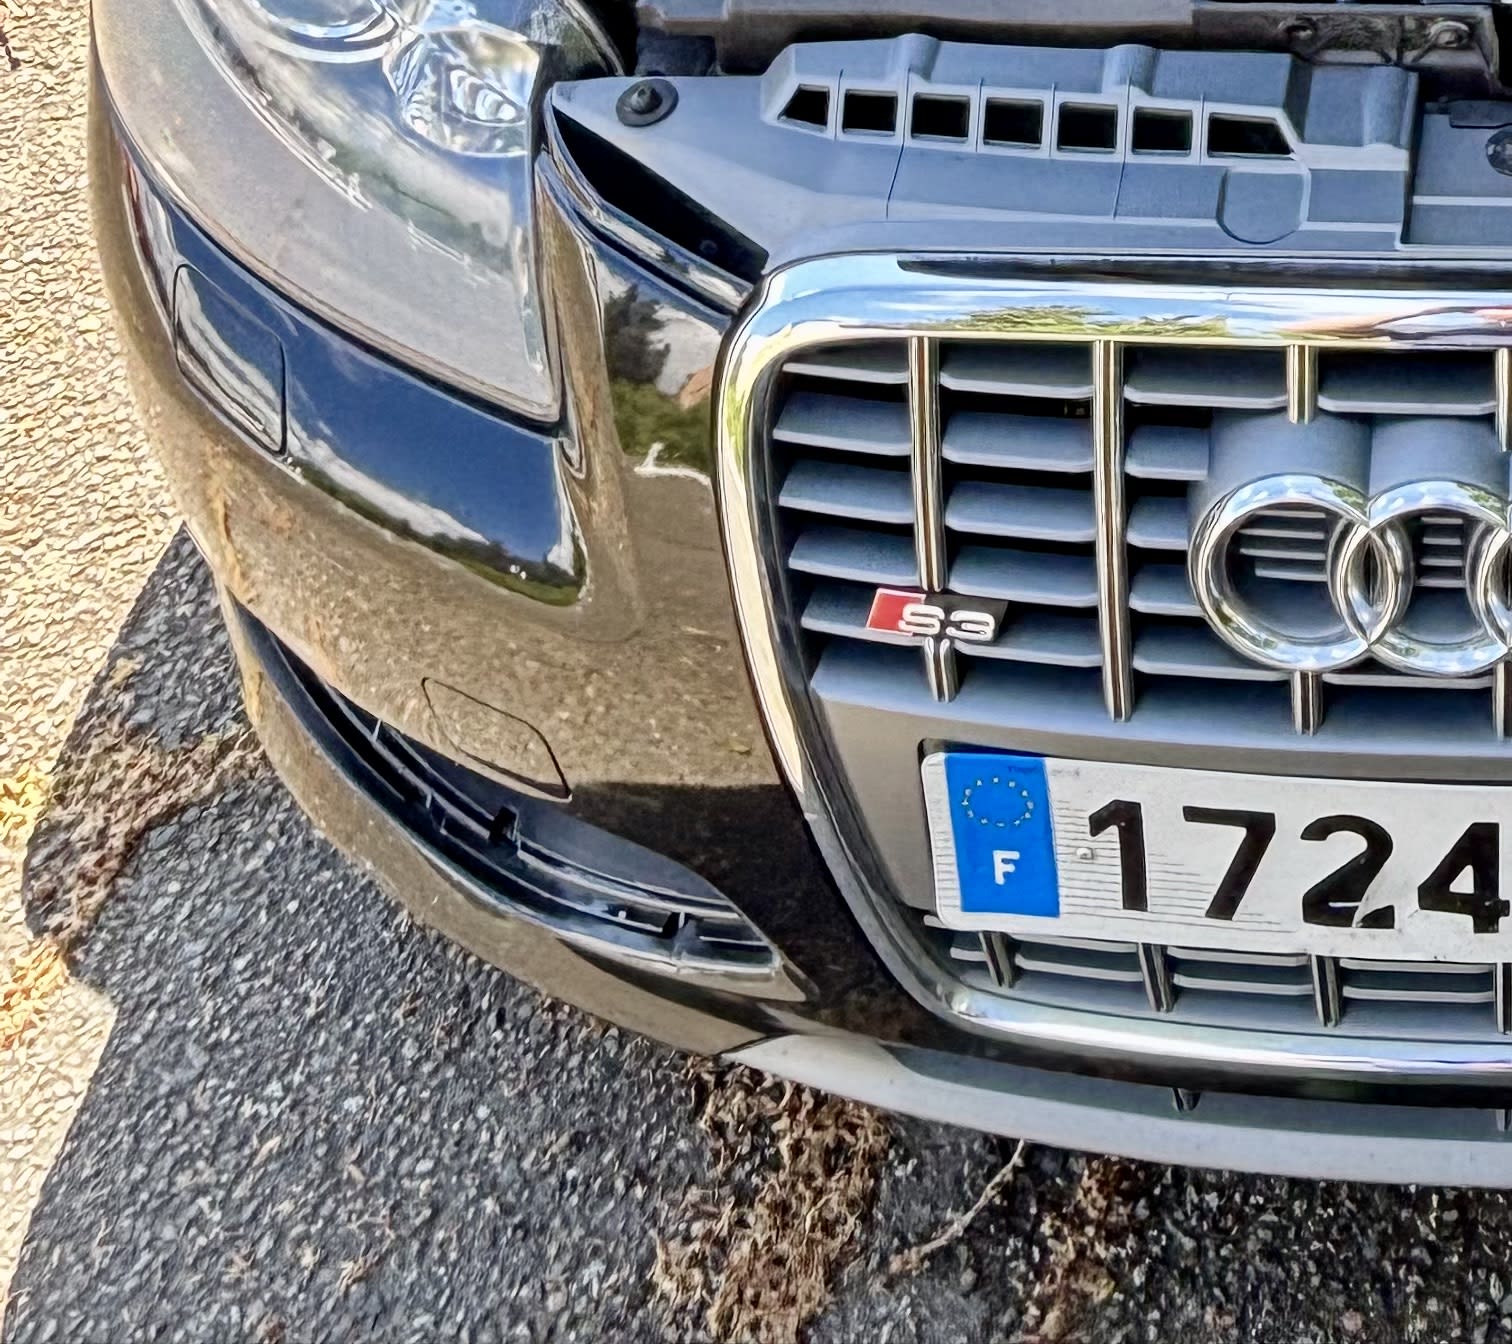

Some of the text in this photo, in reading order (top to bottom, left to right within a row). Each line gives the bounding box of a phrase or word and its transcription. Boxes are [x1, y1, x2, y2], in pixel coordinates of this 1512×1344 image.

[898, 603, 995, 642] S3
[993, 849, 1020, 885] F
[1088, 799, 1511, 934] 1724
